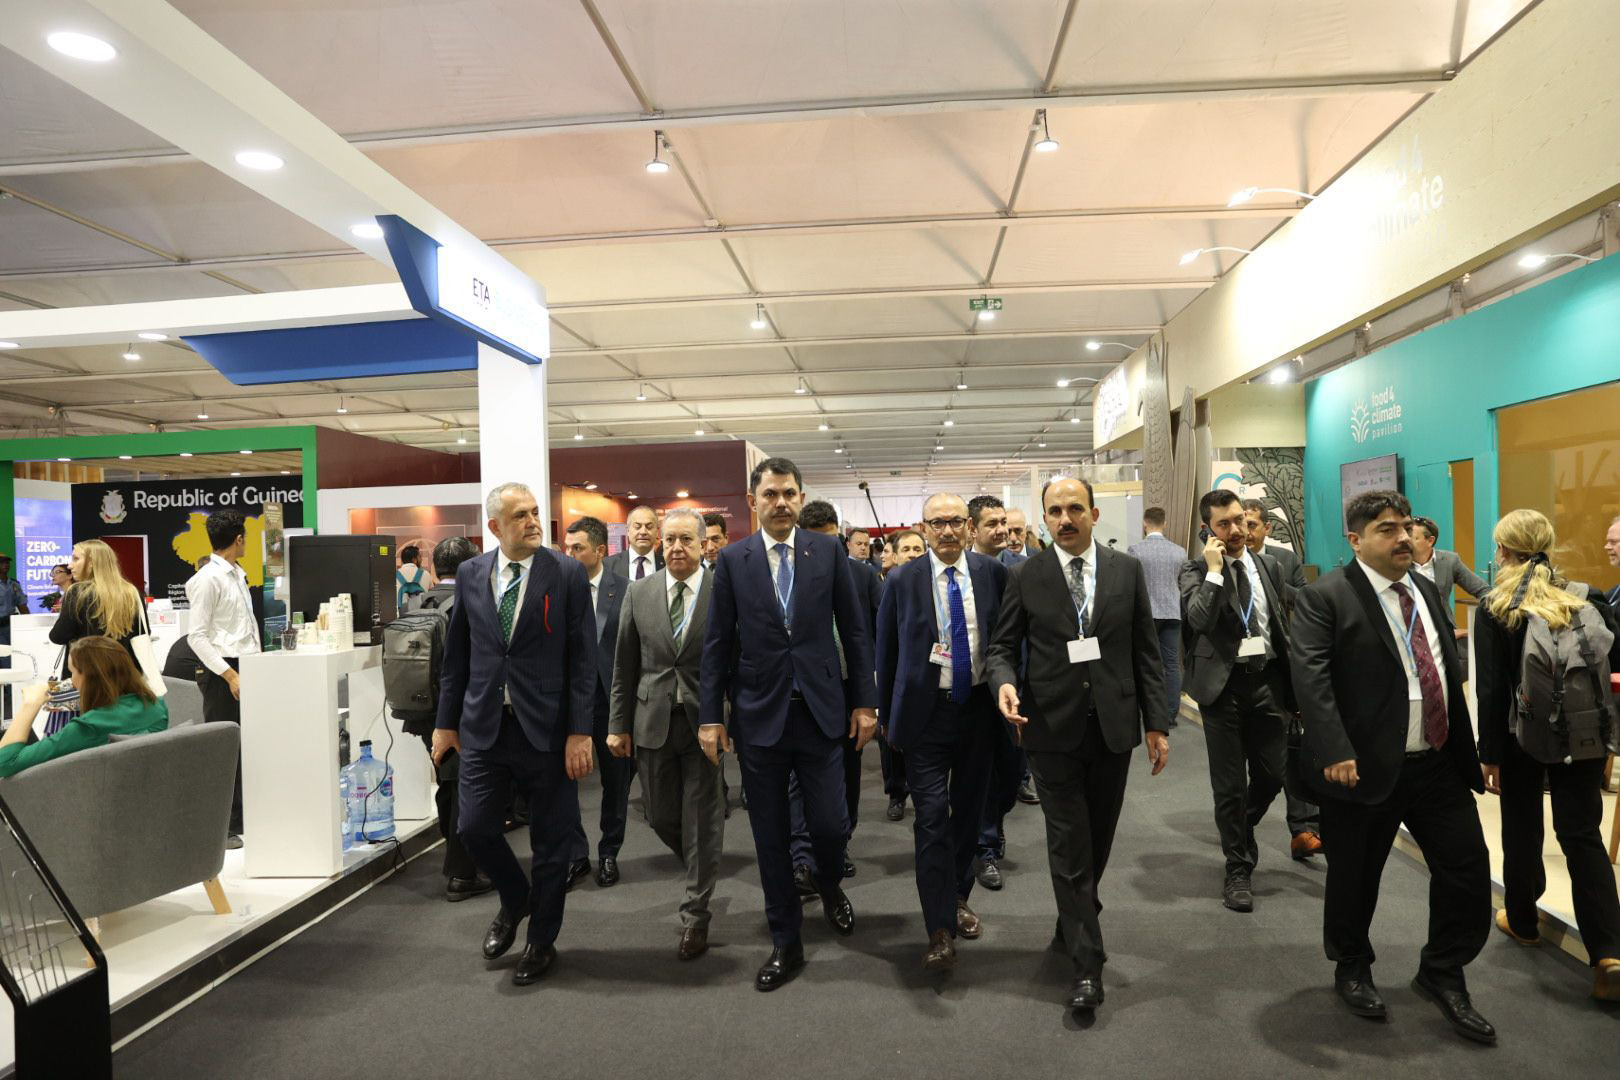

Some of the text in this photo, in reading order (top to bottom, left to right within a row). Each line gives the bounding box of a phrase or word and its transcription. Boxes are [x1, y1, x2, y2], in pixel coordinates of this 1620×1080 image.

[472, 277, 491, 304] ETA
[1371, 385, 1395, 408] food 4
[1371, 403, 1402, 424] climate
[1372, 423, 1404, 441] pavilion
[133, 488, 214, 511] Republic
[218, 486, 238, 505] of
[26, 541, 61, 553] ZERO-
[26, 555, 73, 567] CARBON
